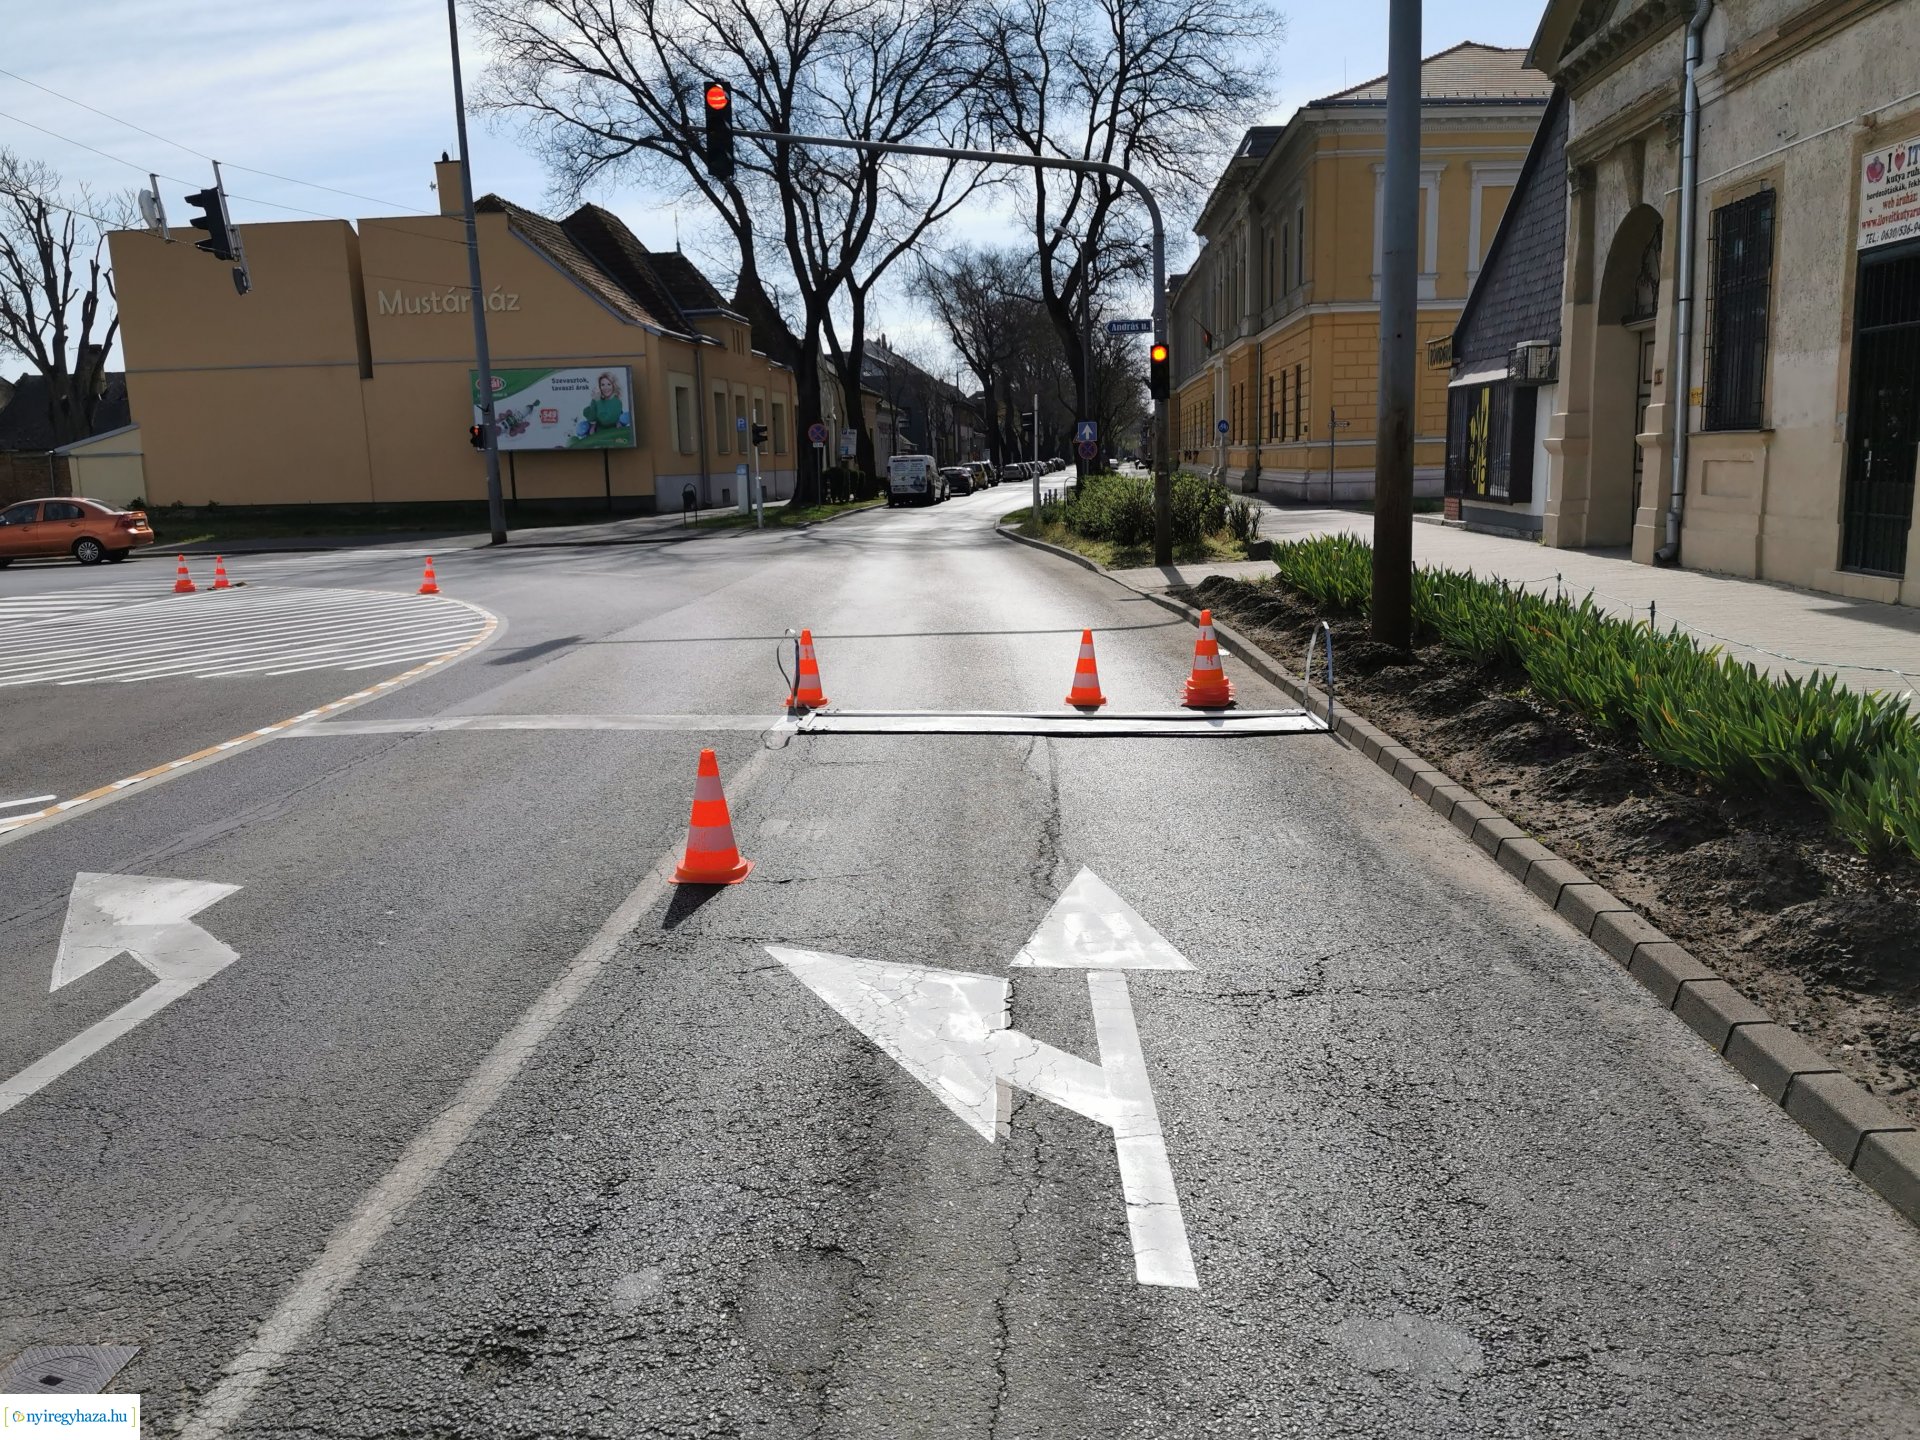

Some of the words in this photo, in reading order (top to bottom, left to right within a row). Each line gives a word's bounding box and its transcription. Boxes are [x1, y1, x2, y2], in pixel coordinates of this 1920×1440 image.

[1886, 173, 1905, 184] kutya
[1907, 166, 1920, 178] ruh
[1883, 197, 1895, 209] web
[1111, 322, 1139, 332] András
